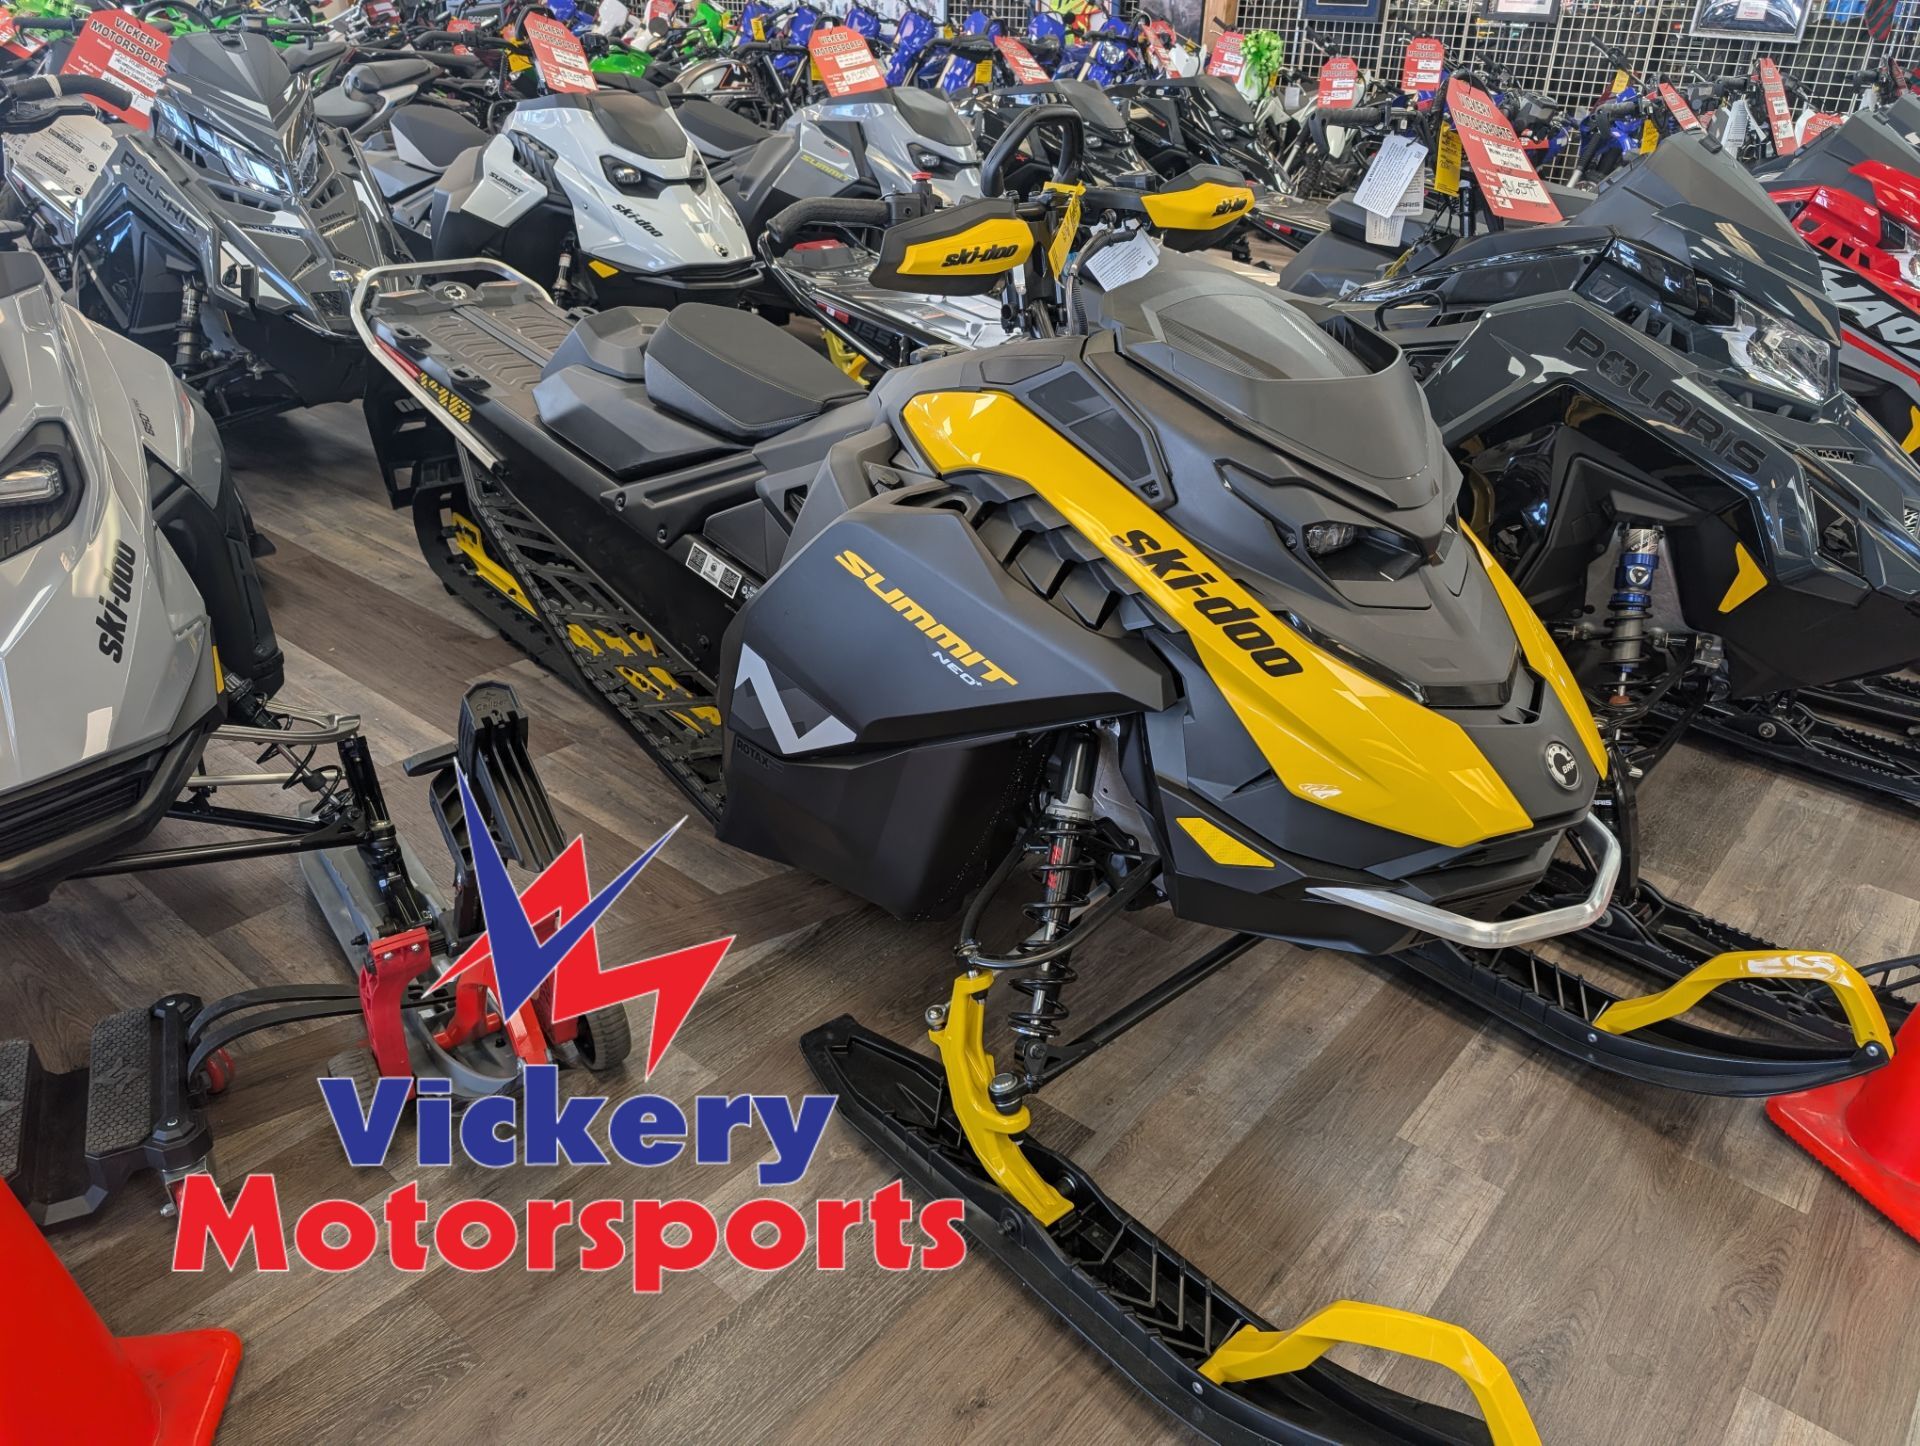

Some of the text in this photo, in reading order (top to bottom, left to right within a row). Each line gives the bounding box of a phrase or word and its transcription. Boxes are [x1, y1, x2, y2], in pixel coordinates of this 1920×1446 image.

[91, 20, 169, 72] MOTORSPORTS
[115, 17, 164, 49] VICKERY
[813, 40, 865, 57] MOTORSPORTS
[818, 32, 849, 44] VICKERY
[1456, 92, 1492, 118] VICKERY
[1452, 108, 1516, 143] MOTORSPORTS
[120, 150, 200, 236] POLARIS
[488, 170, 524, 194] SUMMIT
[612, 203, 664, 238] ski-doo
[1211, 198, 1248, 217] ski-doo
[941, 243, 1018, 268] ski-doo
[1564, 327, 1768, 476] POLARIS
[96, 539, 137, 665] ski-doo
[834, 549, 1019, 687] SUMMIT
[1111, 529, 1304, 679] ski-doo
[736, 738, 770, 769] ROTAX
[1562, 760, 1576, 774] BRP
